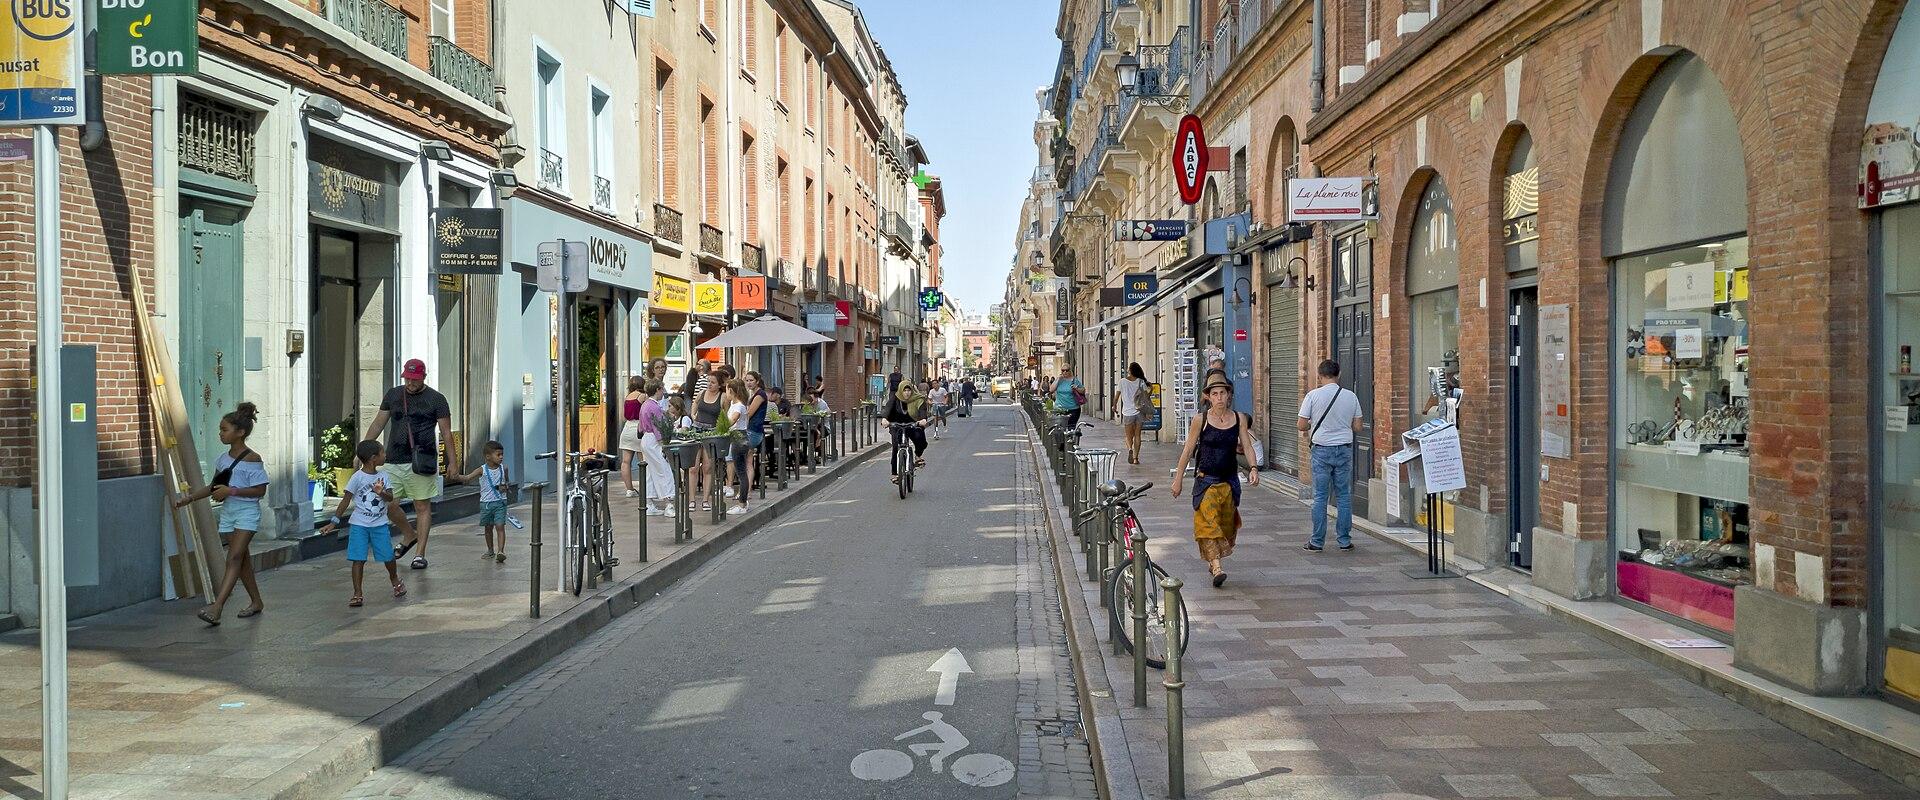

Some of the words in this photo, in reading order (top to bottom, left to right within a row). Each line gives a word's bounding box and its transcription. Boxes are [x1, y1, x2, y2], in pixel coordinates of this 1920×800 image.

[22, 0, 72, 19] BUS
[130, 45, 184, 68] Bon
[53, 105, 75, 113] 22330
[1186, 137, 1195, 179] TABAC
[1296, 187, 1312, 198] La
[1306, 183, 1340, 208] plume
[461, 228, 500, 236] INSTITUT
[1133, 281, 1149, 290] OR
